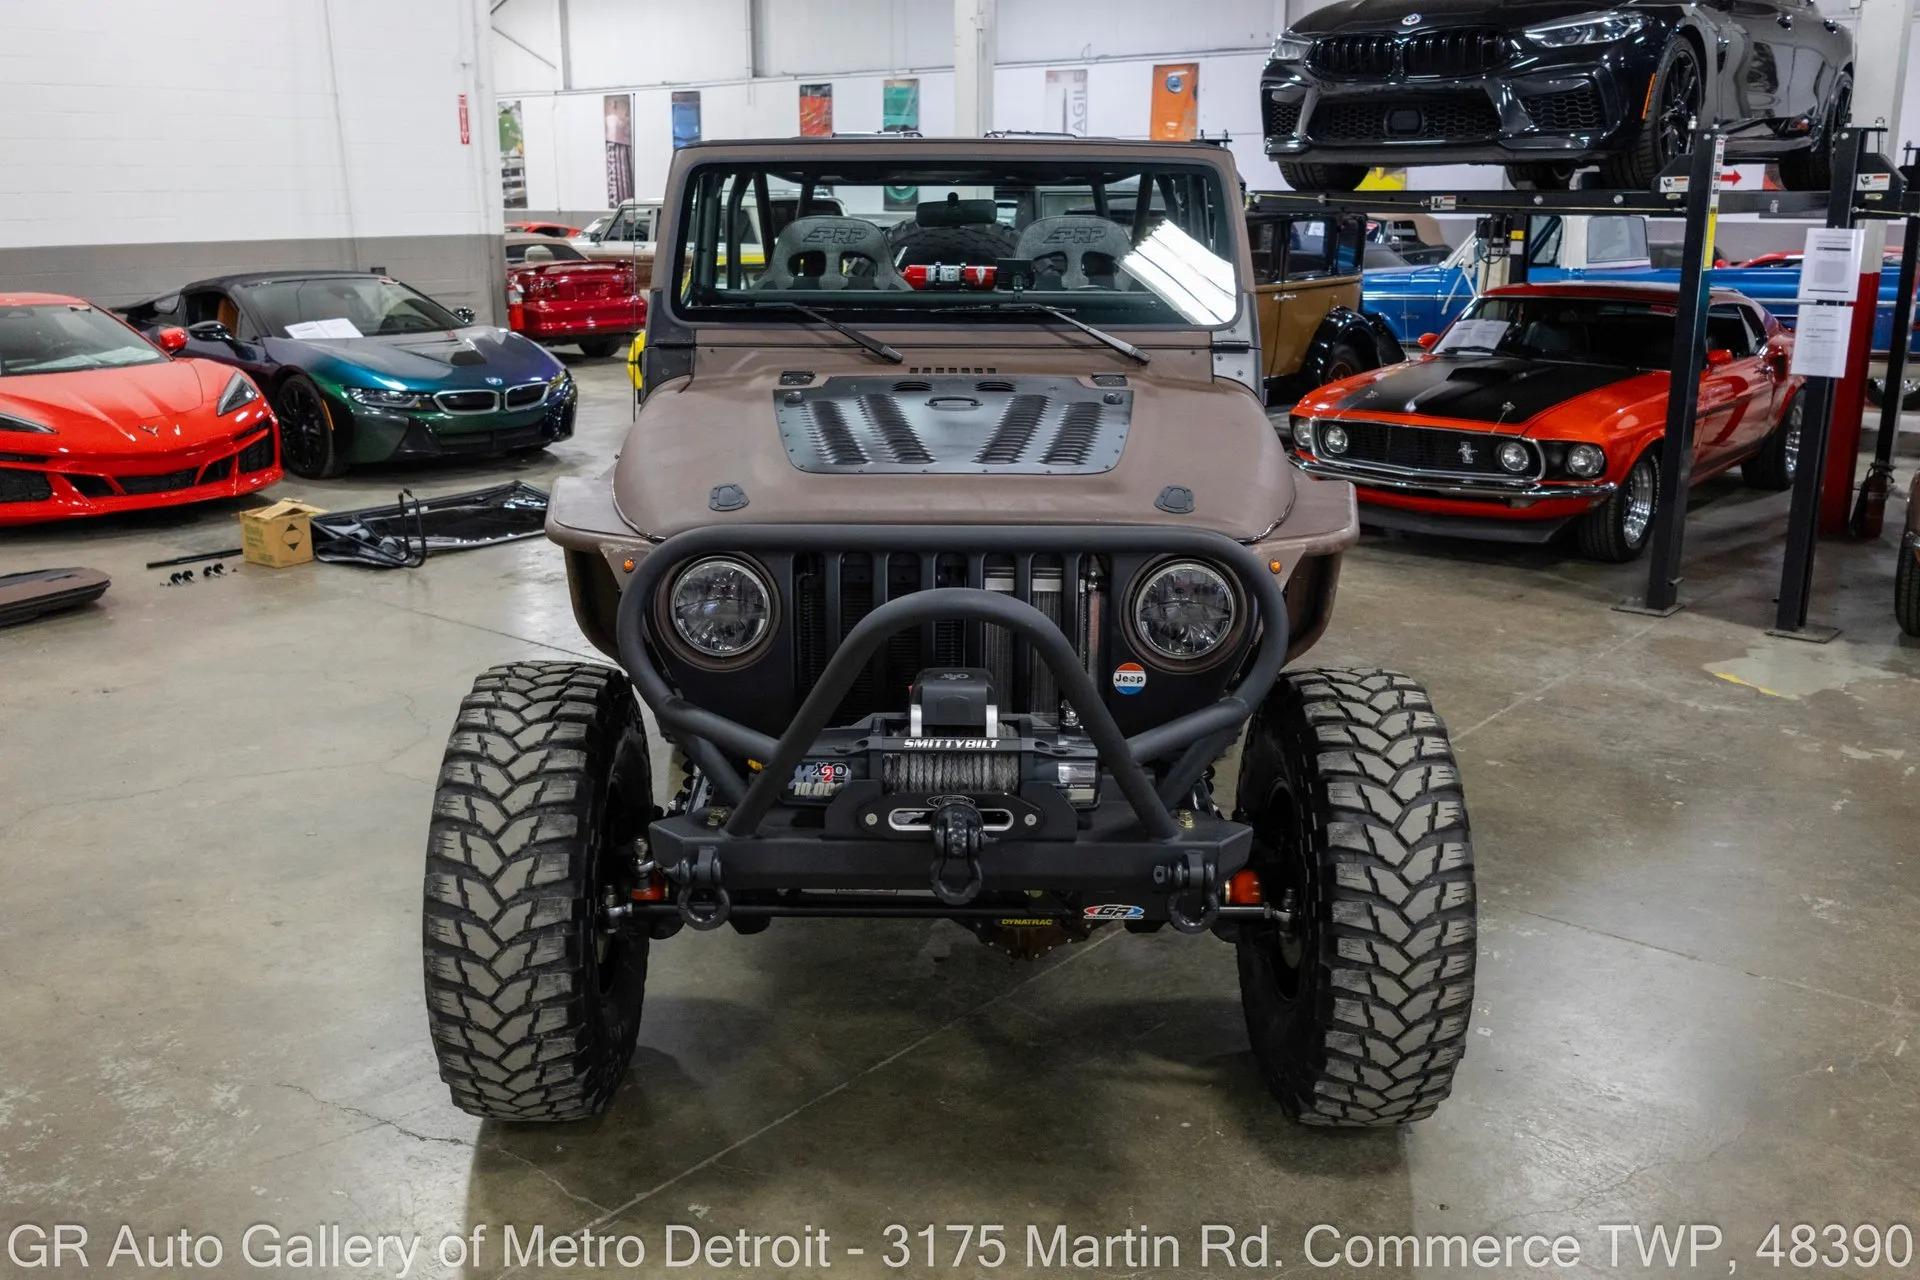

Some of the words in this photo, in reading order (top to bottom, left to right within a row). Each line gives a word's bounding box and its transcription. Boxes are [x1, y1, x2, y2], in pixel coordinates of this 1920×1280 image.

[1115, 673, 1144, 684] Jeep
[903, 738, 1000, 749] SMITTYBILT
[1001, 918, 1054, 926] DYNATRAC
